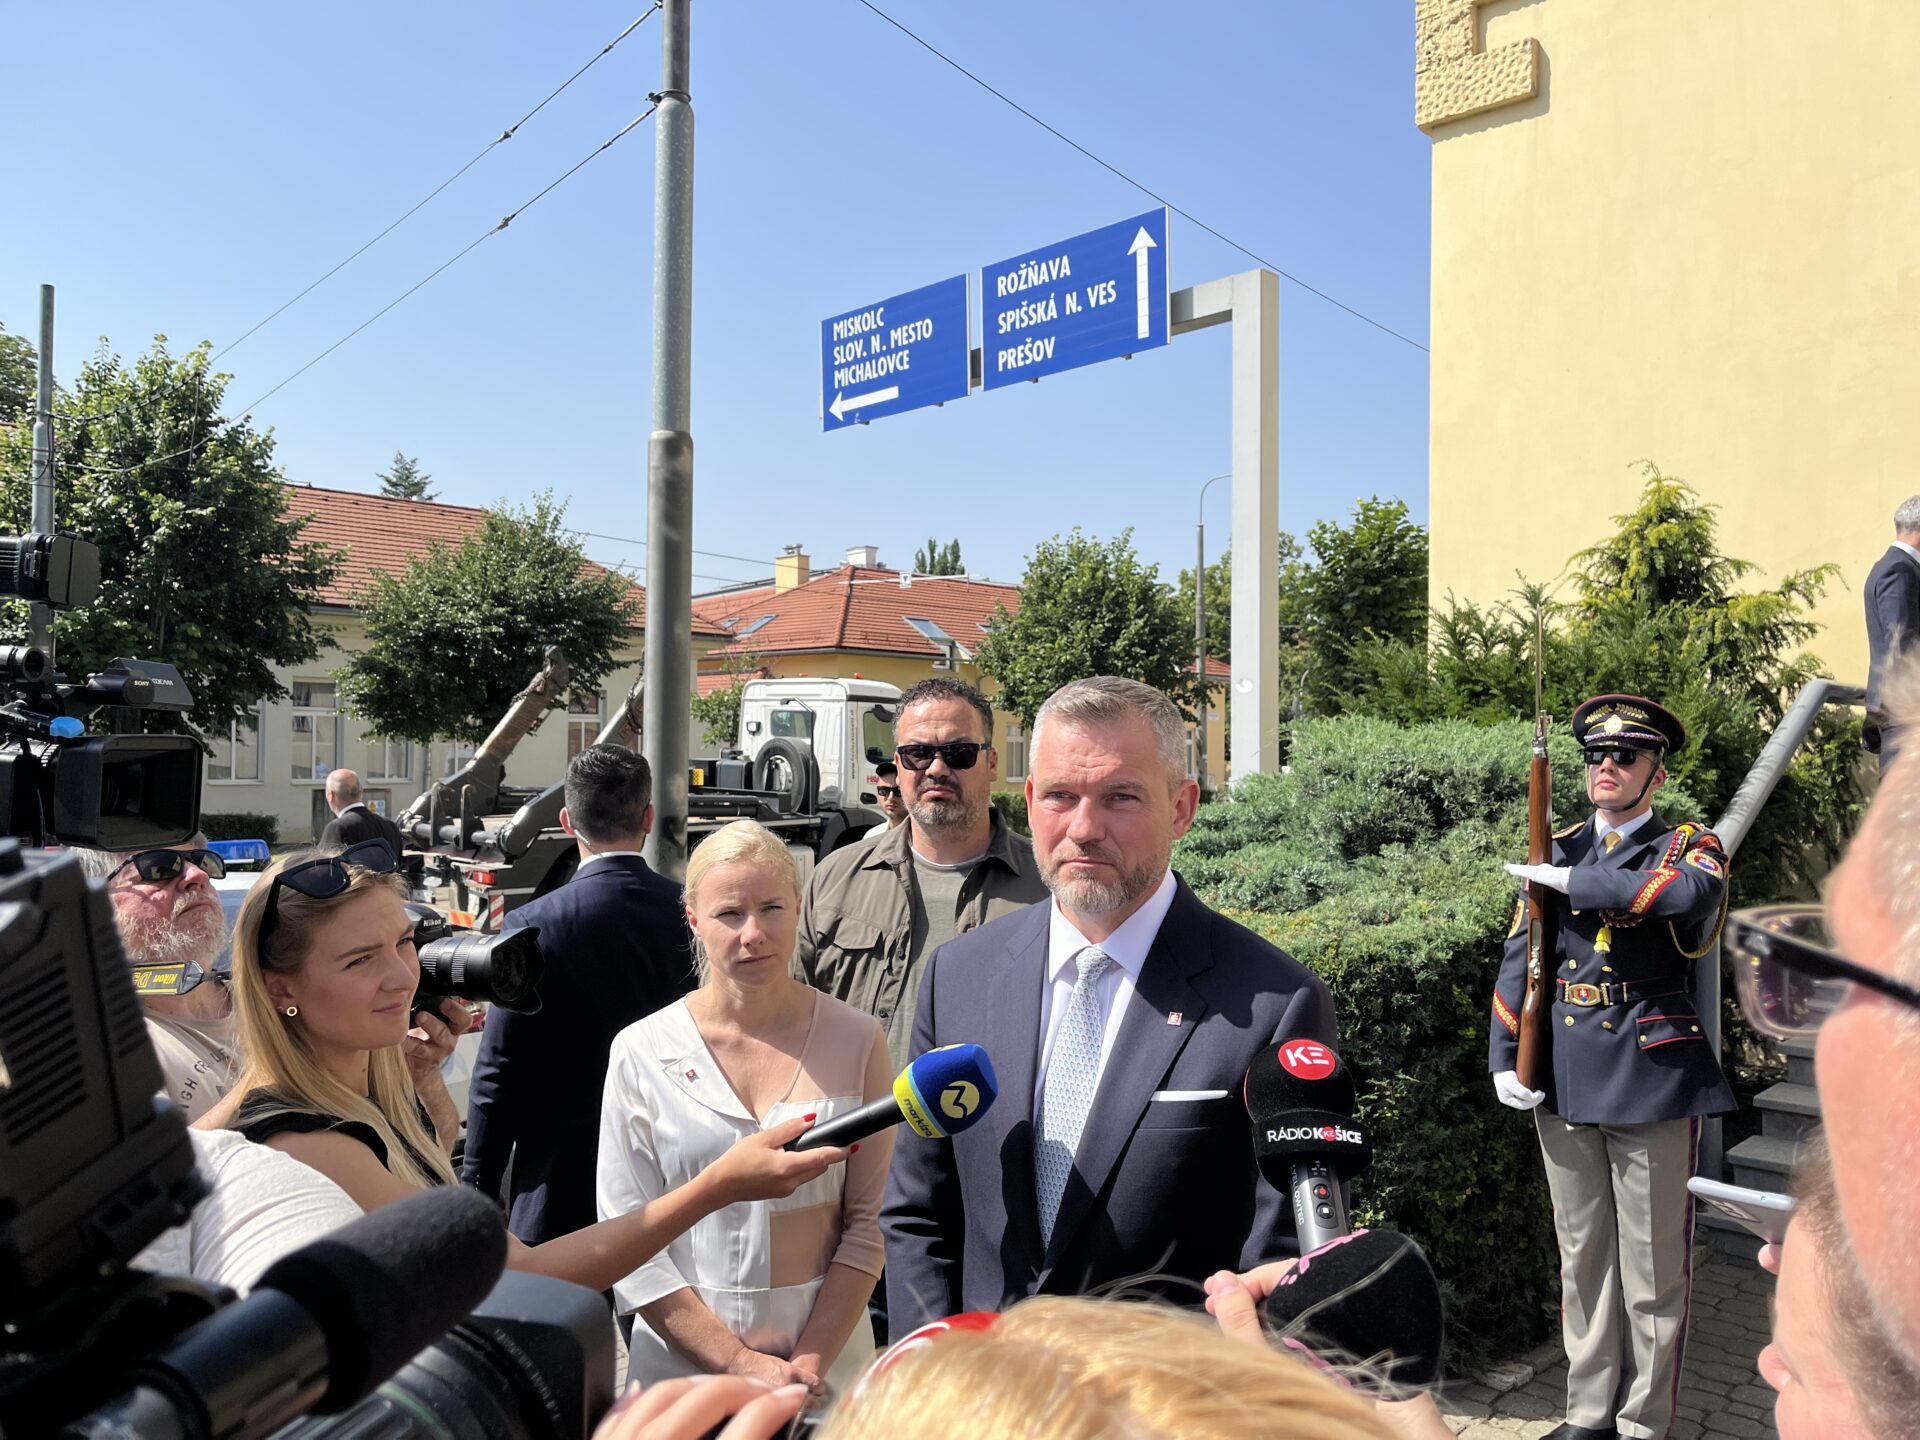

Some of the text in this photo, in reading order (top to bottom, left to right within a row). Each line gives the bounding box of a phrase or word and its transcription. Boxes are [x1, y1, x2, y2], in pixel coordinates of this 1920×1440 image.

[997, 255, 1071, 298] ROŽŇAVA
[833, 307, 884, 341] MISKOLC
[997, 280, 1117, 334] SPIŠSKÁ N. VES
[833, 318, 933, 366] SLOV. N. MESTO
[998, 336, 1056, 372] PREŠOV
[834, 349, 910, 389] MICHALOVCE
[423, 918, 442, 927] Nikon
[1285, 1046, 1330, 1067] KE
[903, 1098, 933, 1137] markiza
[1267, 1126, 1312, 1142] RÁDIO
